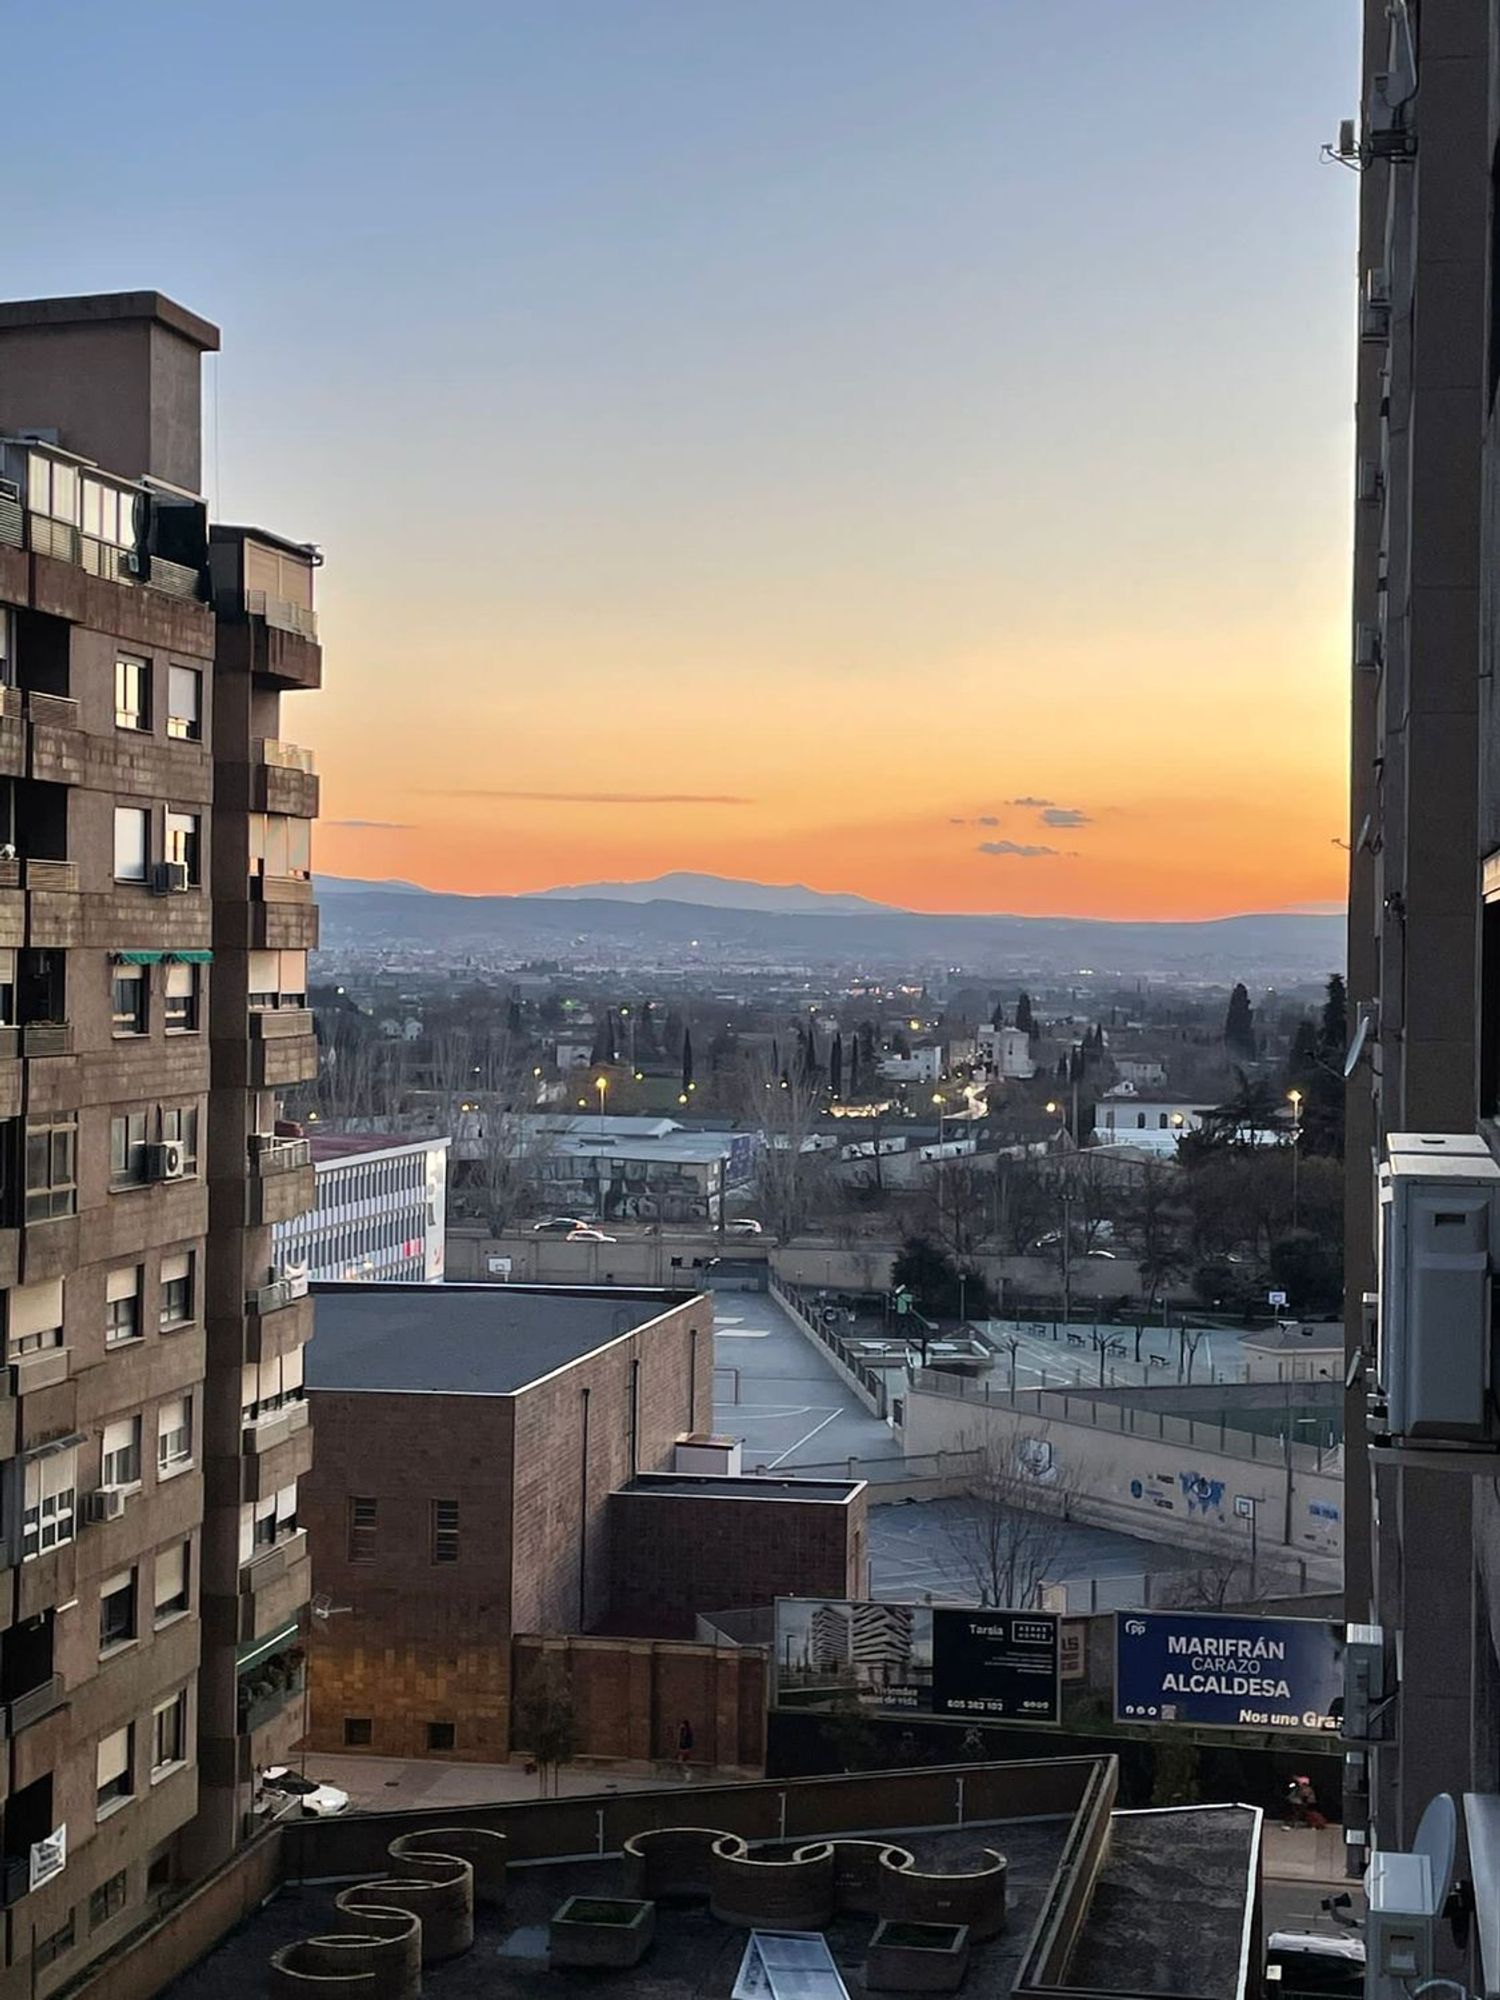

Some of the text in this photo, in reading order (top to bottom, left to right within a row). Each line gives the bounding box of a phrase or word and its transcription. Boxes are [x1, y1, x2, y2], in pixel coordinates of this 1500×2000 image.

[1168, 1636, 1285, 1660] MARIFRÁN
[1191, 1657, 1261, 1675] CARAZO
[1162, 1673, 1291, 1698] ALCALDESA
[1239, 1709, 1268, 1724] Nos
[1270, 1714, 1299, 1726] une
